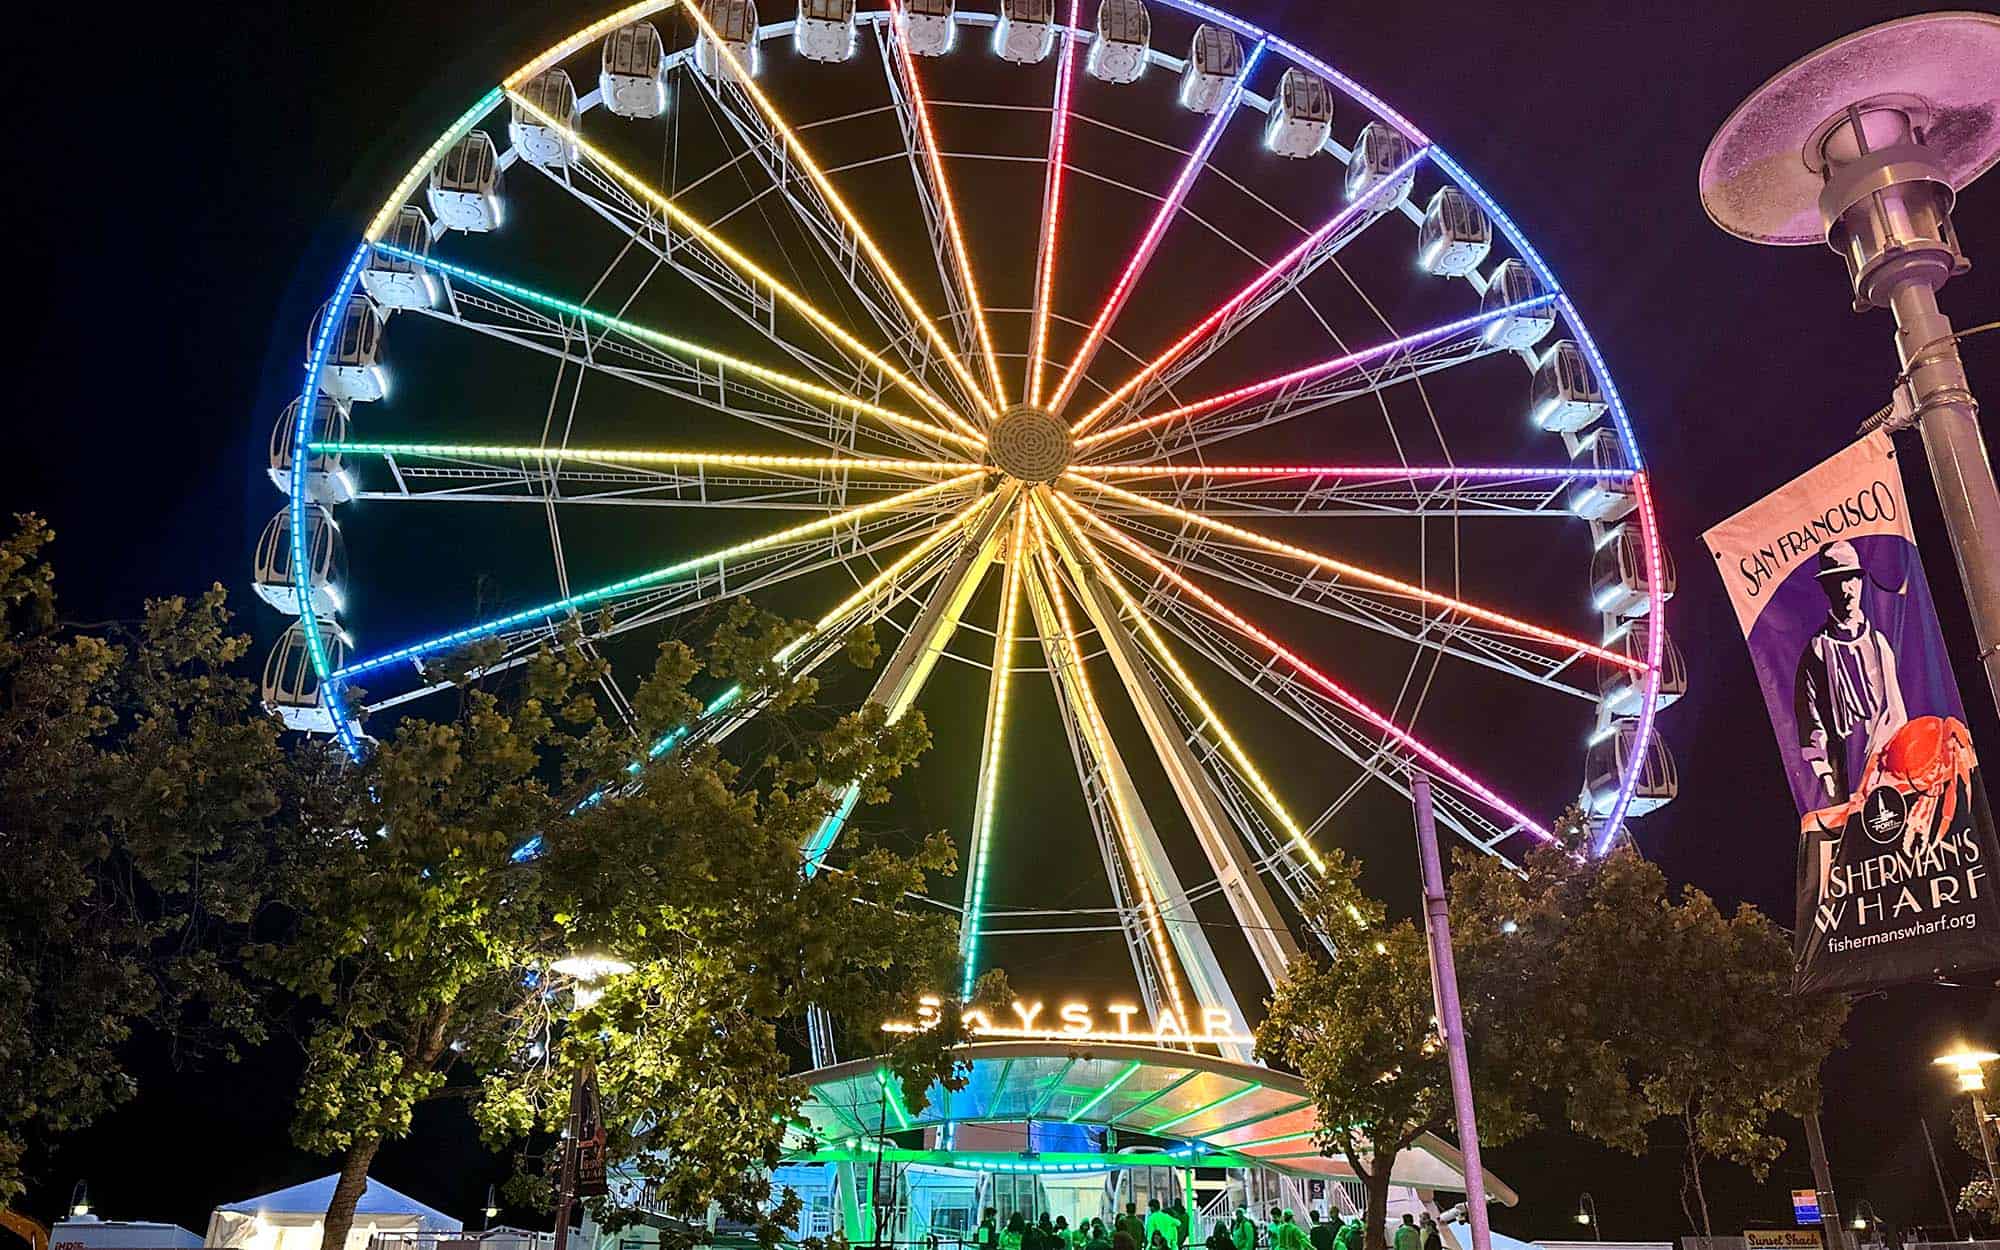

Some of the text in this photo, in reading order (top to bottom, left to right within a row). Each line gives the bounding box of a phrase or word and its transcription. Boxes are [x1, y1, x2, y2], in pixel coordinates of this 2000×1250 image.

[1739, 480, 1897, 597] SAN FRANCISCO
[1814, 864, 1987, 934] WHARF
[1827, 912, 1977, 953] fishermanswharf.org
[1313, 1183, 1321, 1193] 5
